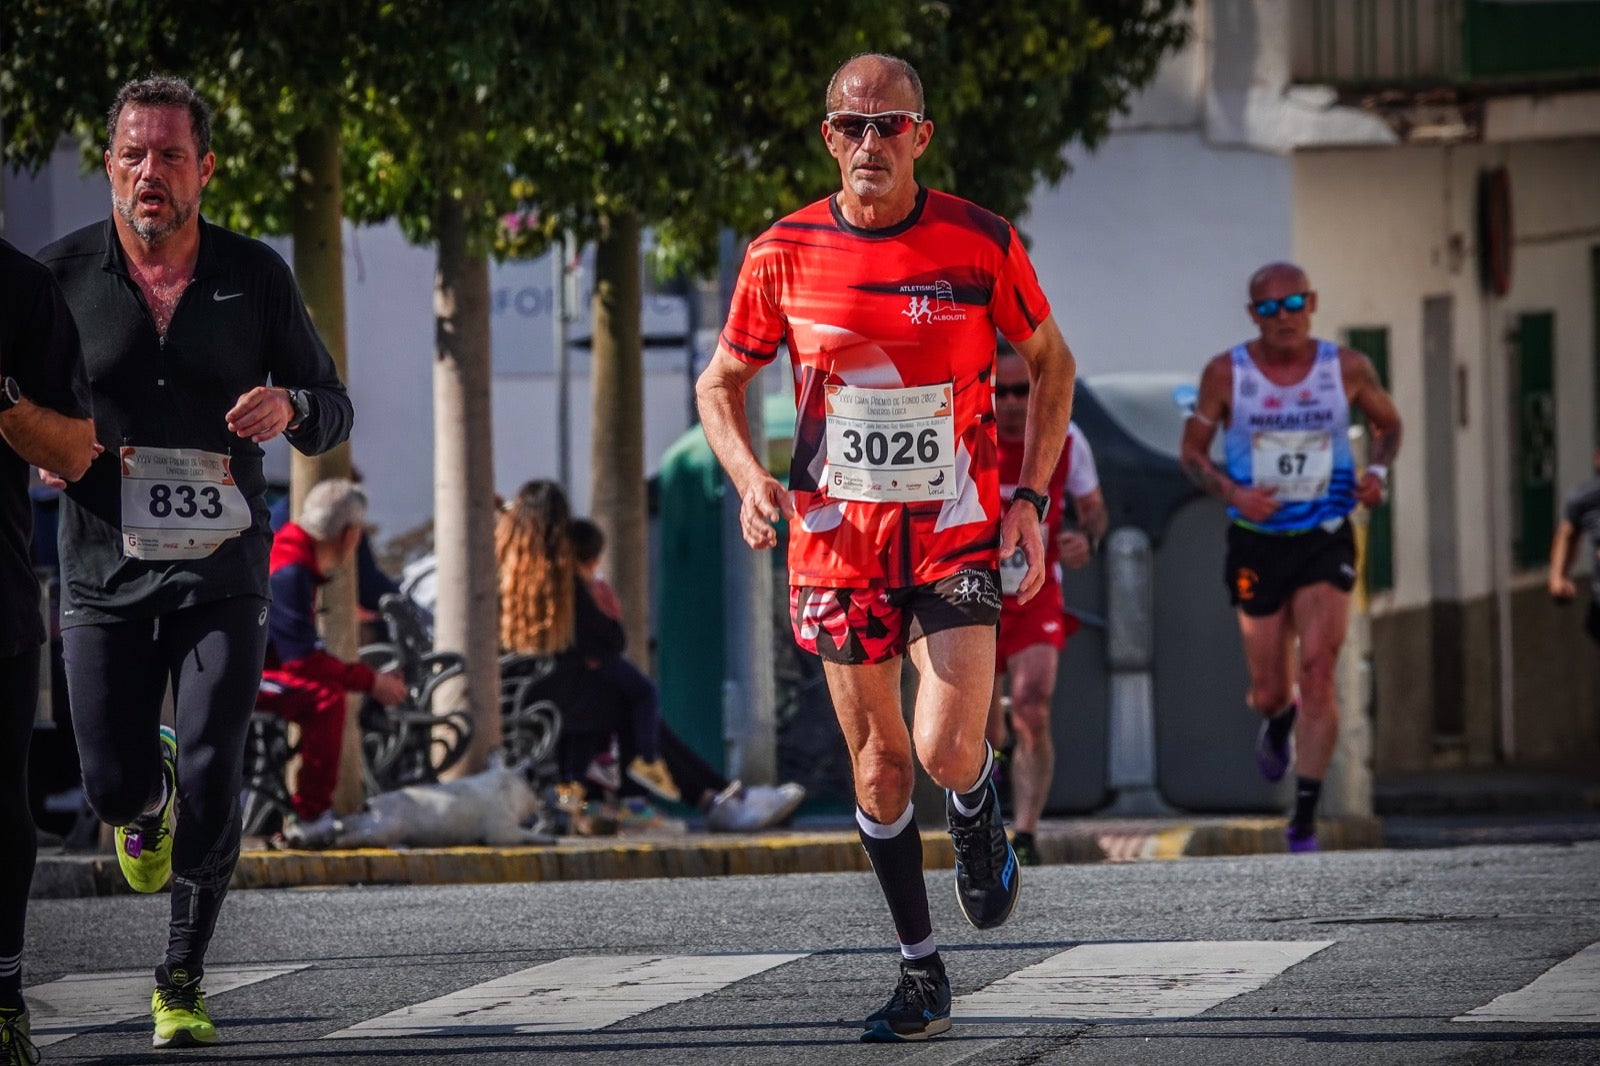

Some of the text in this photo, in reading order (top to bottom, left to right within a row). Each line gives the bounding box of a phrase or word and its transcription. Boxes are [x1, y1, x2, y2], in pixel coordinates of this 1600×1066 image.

[900, 284, 936, 292] ATLETISMO
[933, 313, 967, 321] ALBOLOTE
[920, 393, 937, 404] 2022
[842, 428, 939, 466] 3026
[1278, 453, 1307, 475] 67
[149, 484, 223, 519] 833
